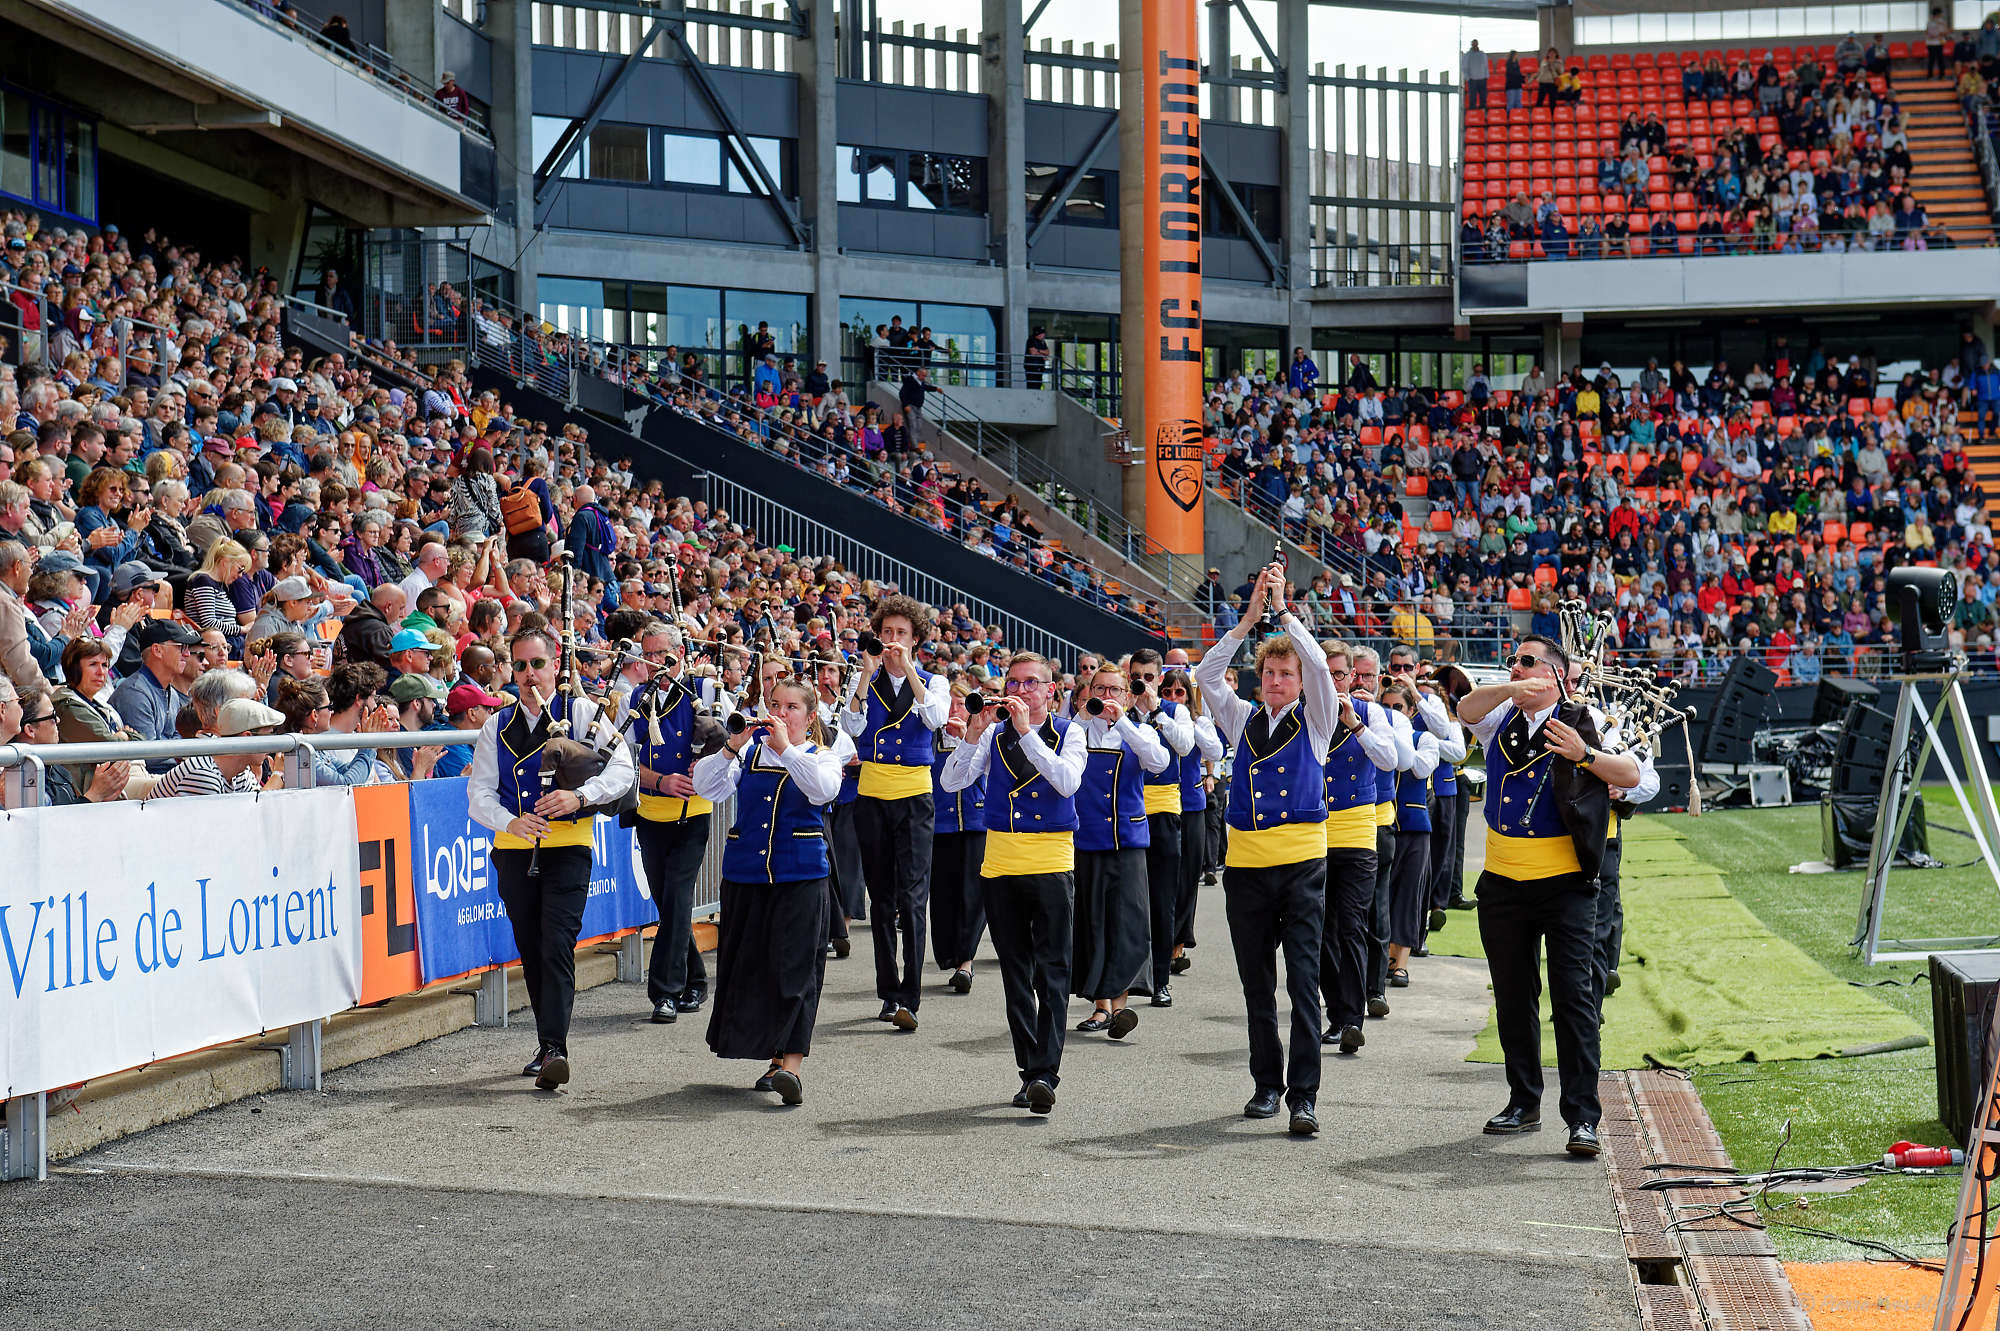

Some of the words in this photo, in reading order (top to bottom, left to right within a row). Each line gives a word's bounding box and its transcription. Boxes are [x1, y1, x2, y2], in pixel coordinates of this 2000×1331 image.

[1160, 50, 1200, 274] LORIENT
[1160, 298, 1201, 362] FC
[1158, 446, 1172, 459] FC
[587, 877, 617, 897] ERATION
[0, 890, 118, 999] Ville
[135, 881, 183, 974] de
[195, 866, 339, 961] Lorient
